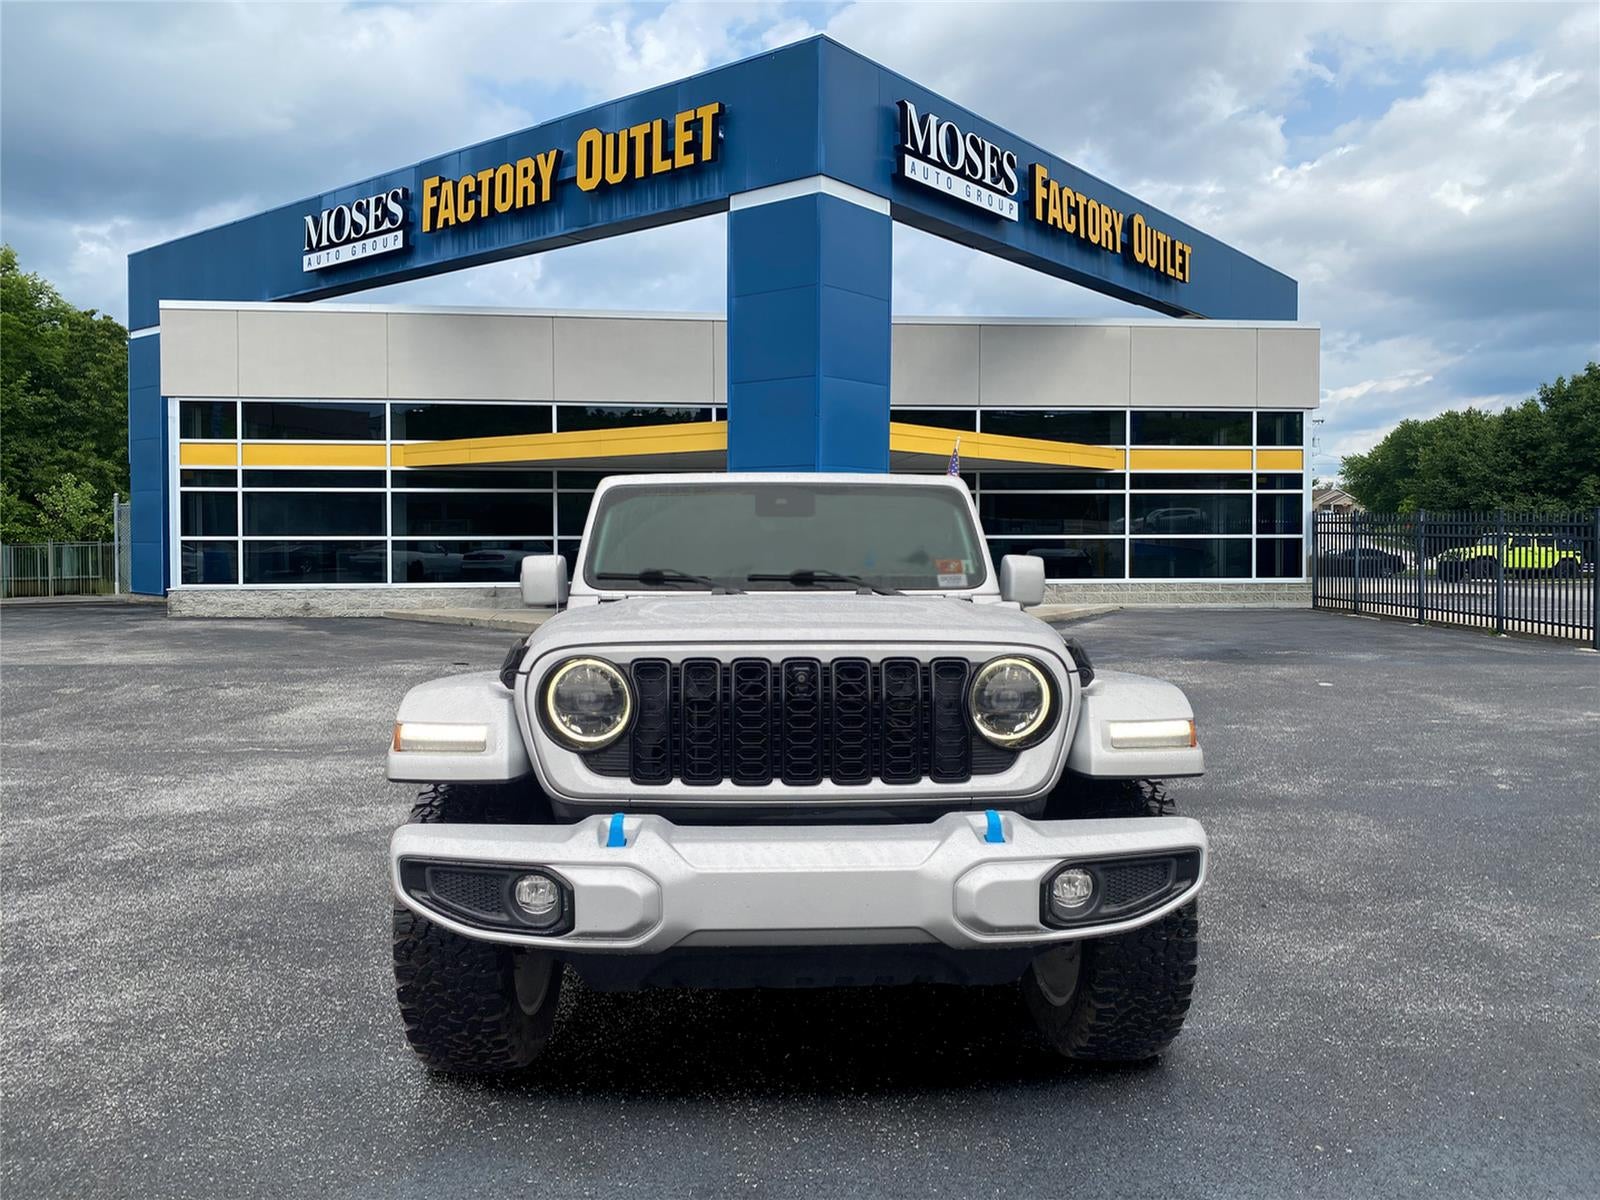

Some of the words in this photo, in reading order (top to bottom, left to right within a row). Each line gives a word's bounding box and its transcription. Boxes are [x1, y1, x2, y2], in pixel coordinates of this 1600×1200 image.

[422, 149, 559, 233] FACTORY
[576, 102, 720, 192] OUTLET
[904, 100, 1019, 196] MOSES
[303, 188, 404, 251] MOSES
[910, 161, 953, 190] AUTO
[965, 182, 1015, 215] GROUP
[1035, 163, 1124, 253] FACTORY
[1132, 212, 1192, 284] OUTLET
[307, 249, 341, 268] AUTO
[351, 234, 400, 257] GROUP
